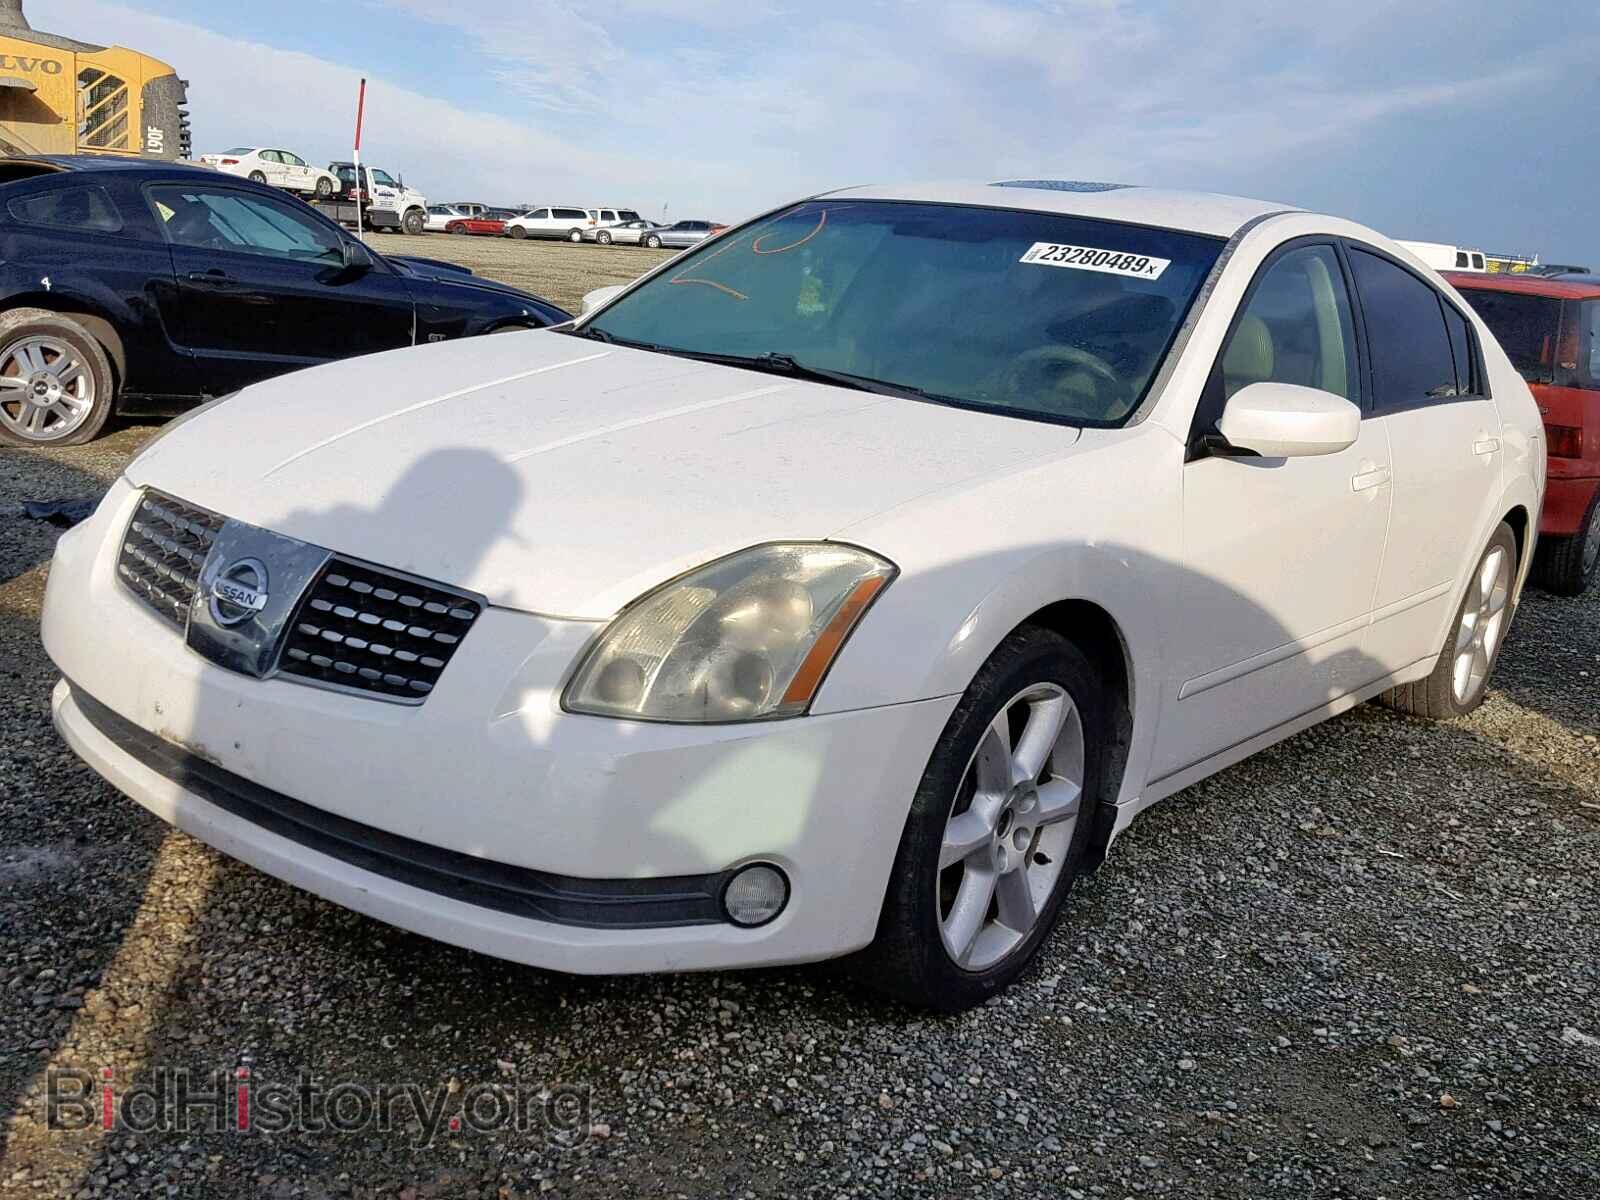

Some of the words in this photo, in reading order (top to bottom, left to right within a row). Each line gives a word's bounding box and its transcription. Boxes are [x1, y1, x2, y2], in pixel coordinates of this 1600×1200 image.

[147, 126, 164, 154] L90F
[1039, 244, 1150, 275] 23280489
[215, 581, 257, 606] SSAN
